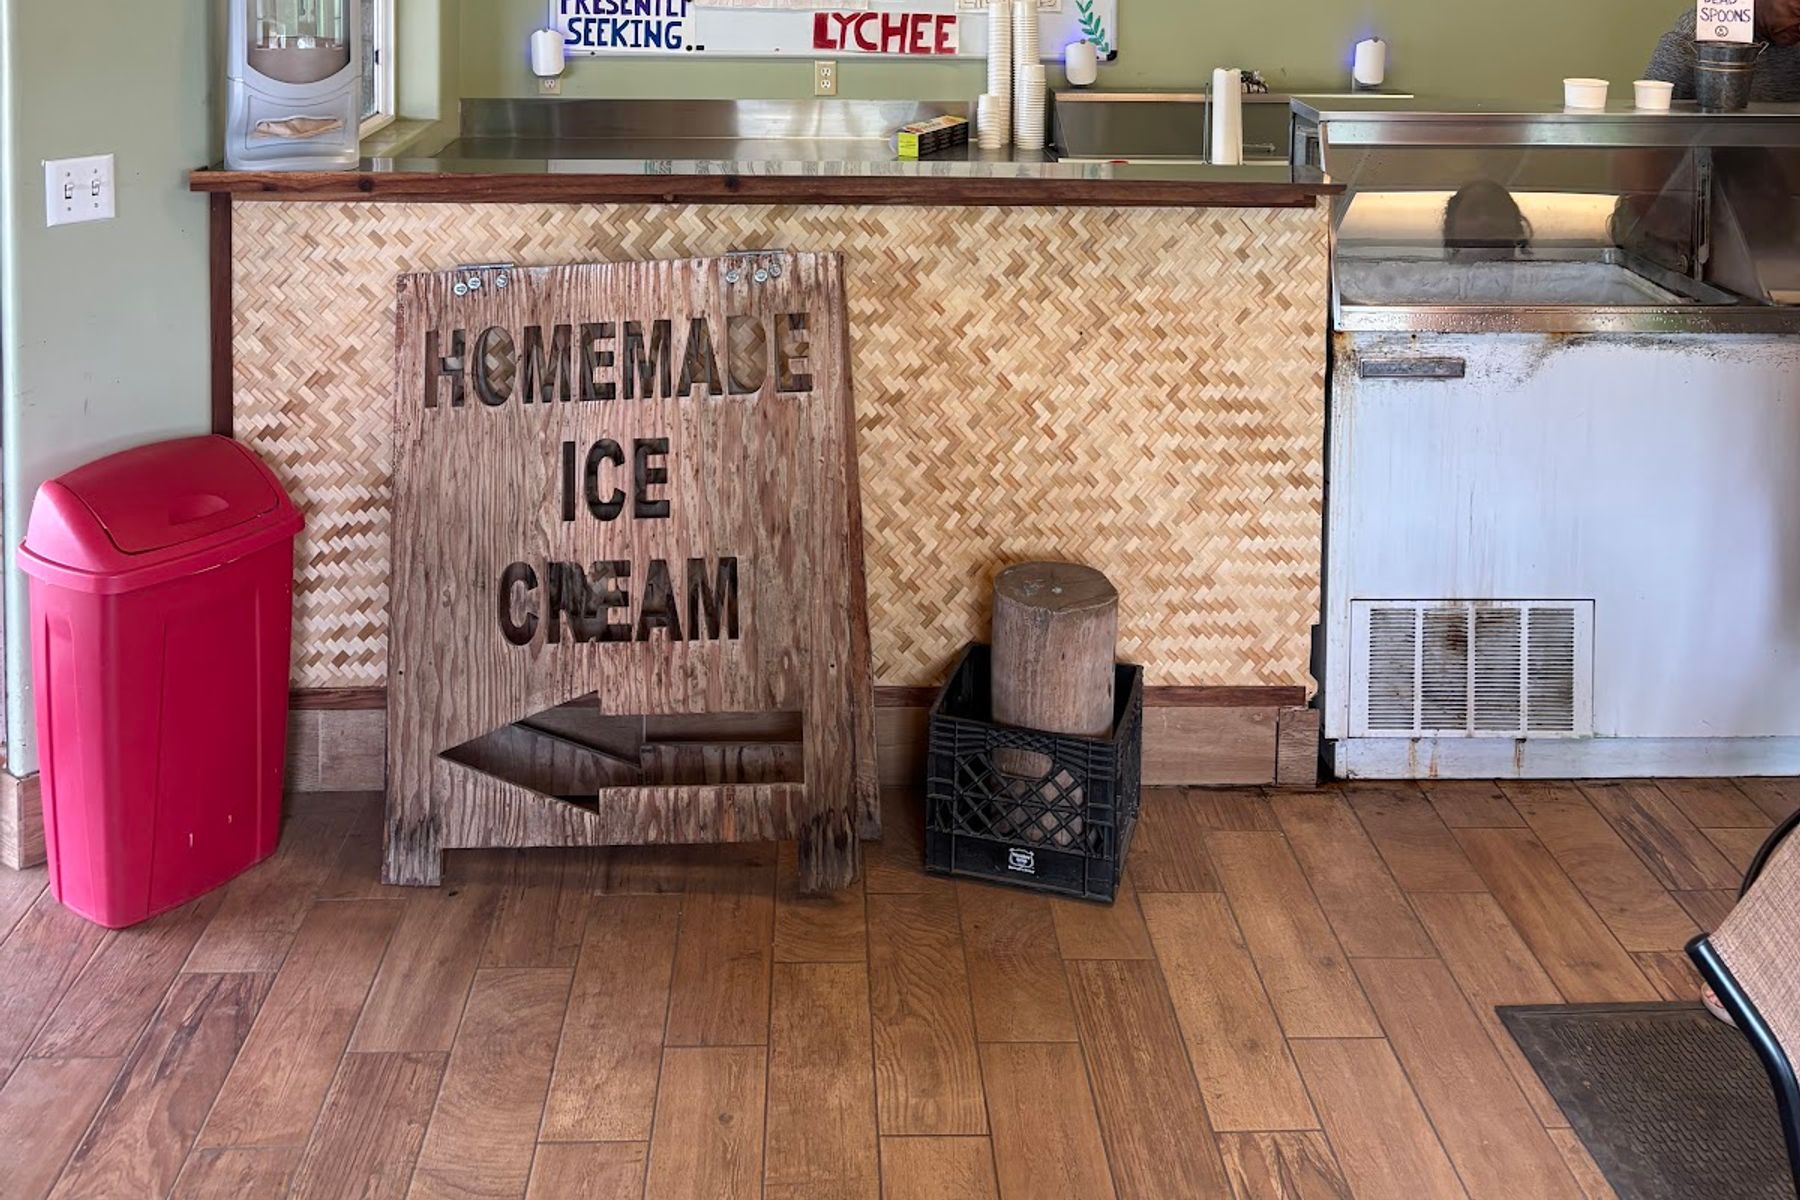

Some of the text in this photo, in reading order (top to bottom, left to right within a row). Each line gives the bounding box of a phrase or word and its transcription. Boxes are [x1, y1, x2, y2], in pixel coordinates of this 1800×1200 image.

[812, 11, 957, 55] LYCHEE
[1699, 7, 1751, 23] SPOONS
[424, 311, 814, 409] HOMEMADE
[561, 436, 671, 523] ICE
[499, 556, 740, 647] CREAM
